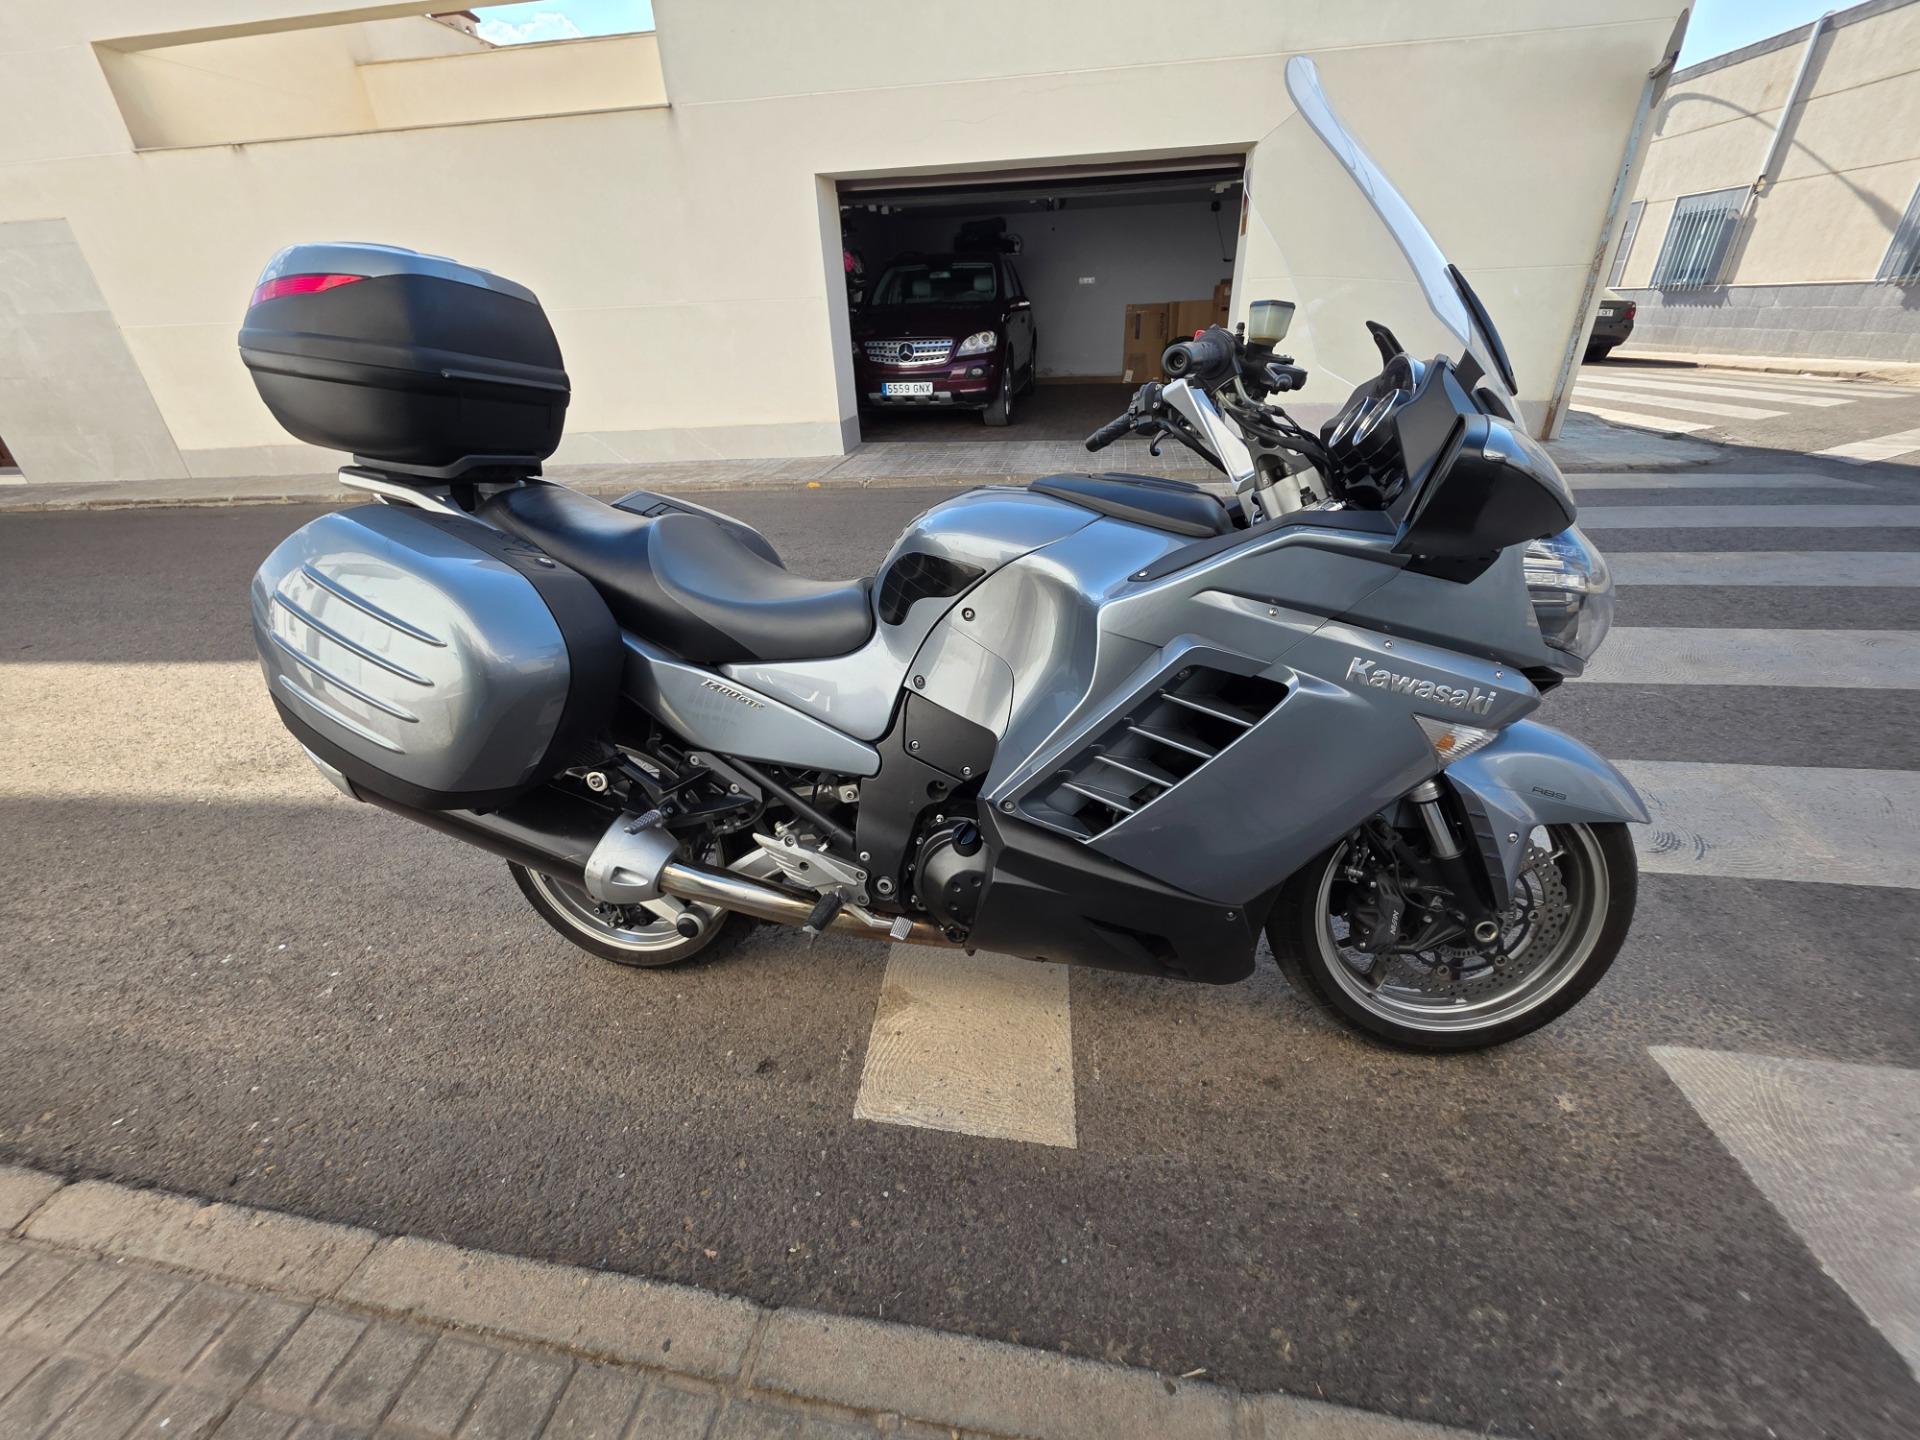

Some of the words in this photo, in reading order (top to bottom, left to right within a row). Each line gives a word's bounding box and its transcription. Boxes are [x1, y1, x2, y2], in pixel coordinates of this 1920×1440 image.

[888, 384, 910, 394] 5559
[913, 384, 931, 393] GNX
[1345, 656, 1497, 715] Kawasaki
[1532, 785, 1568, 801] ABS
